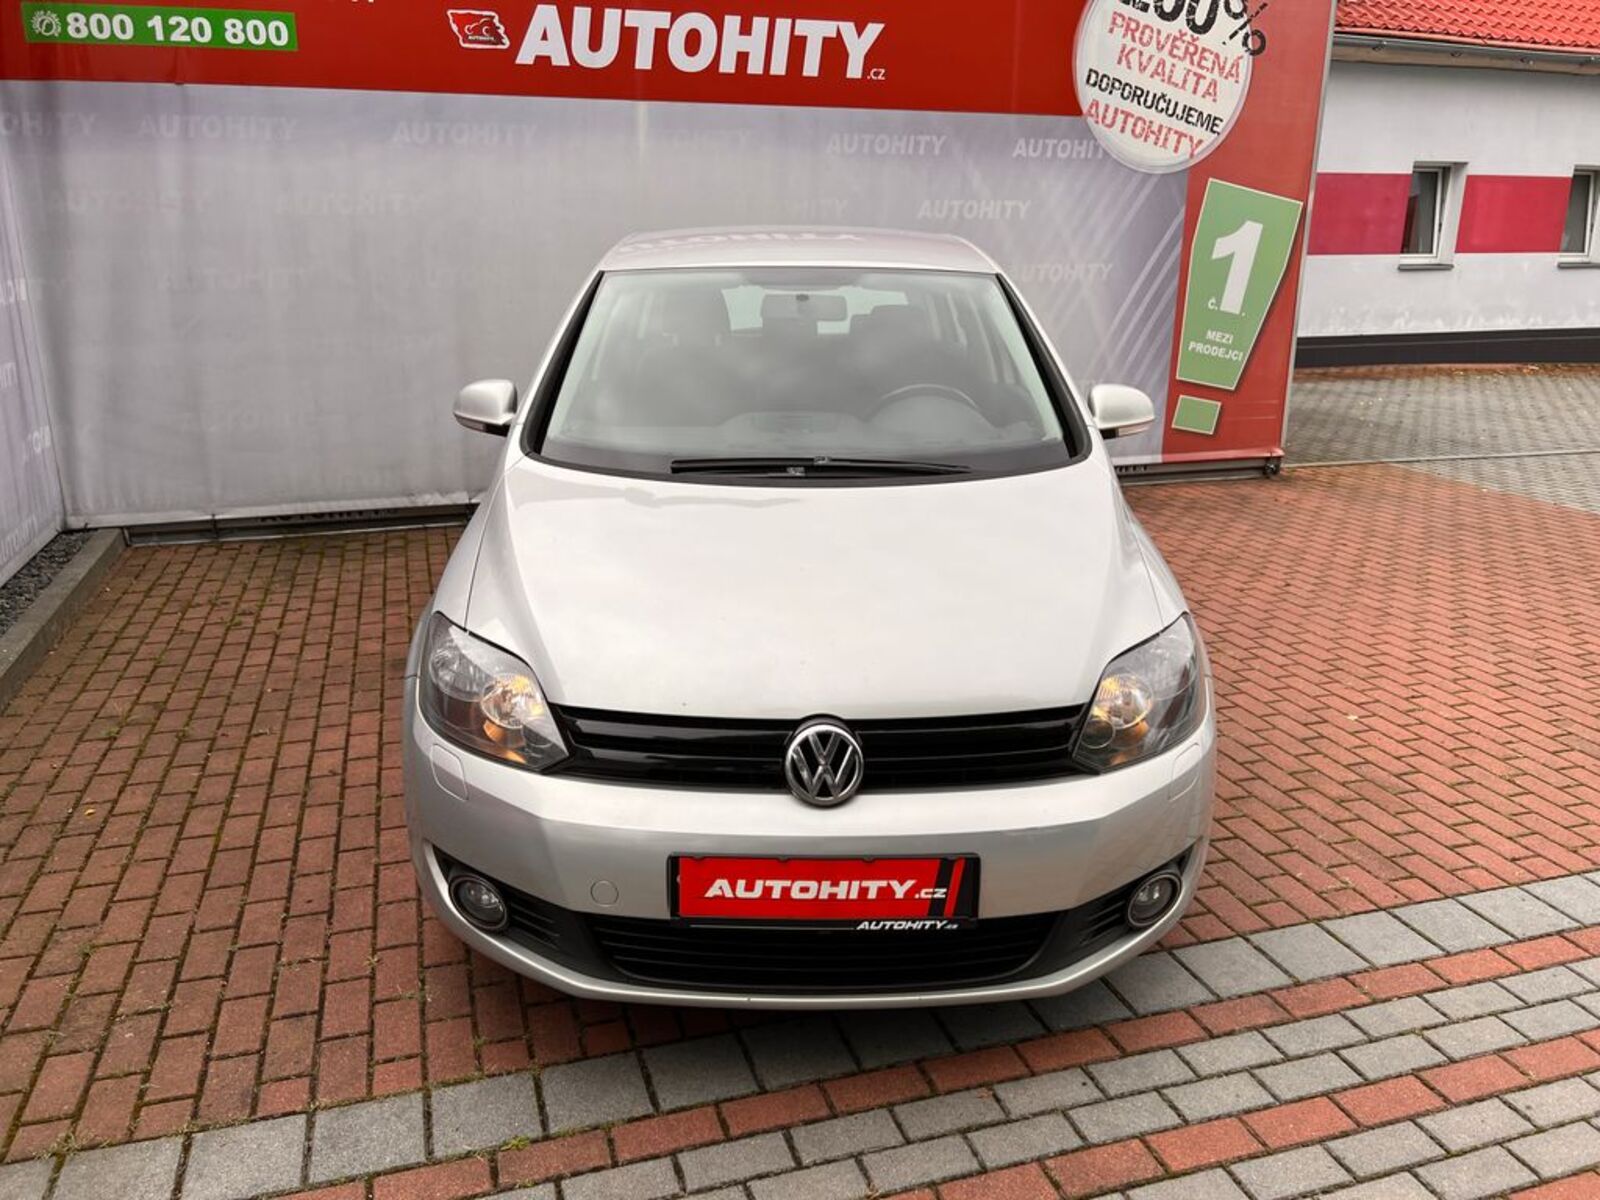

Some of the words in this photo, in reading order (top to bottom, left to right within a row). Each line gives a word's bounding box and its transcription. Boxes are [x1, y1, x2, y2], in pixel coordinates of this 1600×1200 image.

[66, 12, 134, 40] 800
[147, 15, 212, 43] 120
[224, 18, 289, 46] 800
[1108, 11, 1245, 84] PROVĚŘENÁ
[1117, 0, 1267, 56] 0%
[1117, 43, 1218, 103] KVALITA
[1085, 68, 1223, 136] DOPORUČUJEME
[825, 133, 948, 156] AUTOHITY
[1083, 98, 1204, 160] AUTOHITY
[916, 200, 1031, 220] AUTOHITY
[1188, 341, 1243, 361] PRODEJCI
[1206, 329, 1233, 344] MEZI
